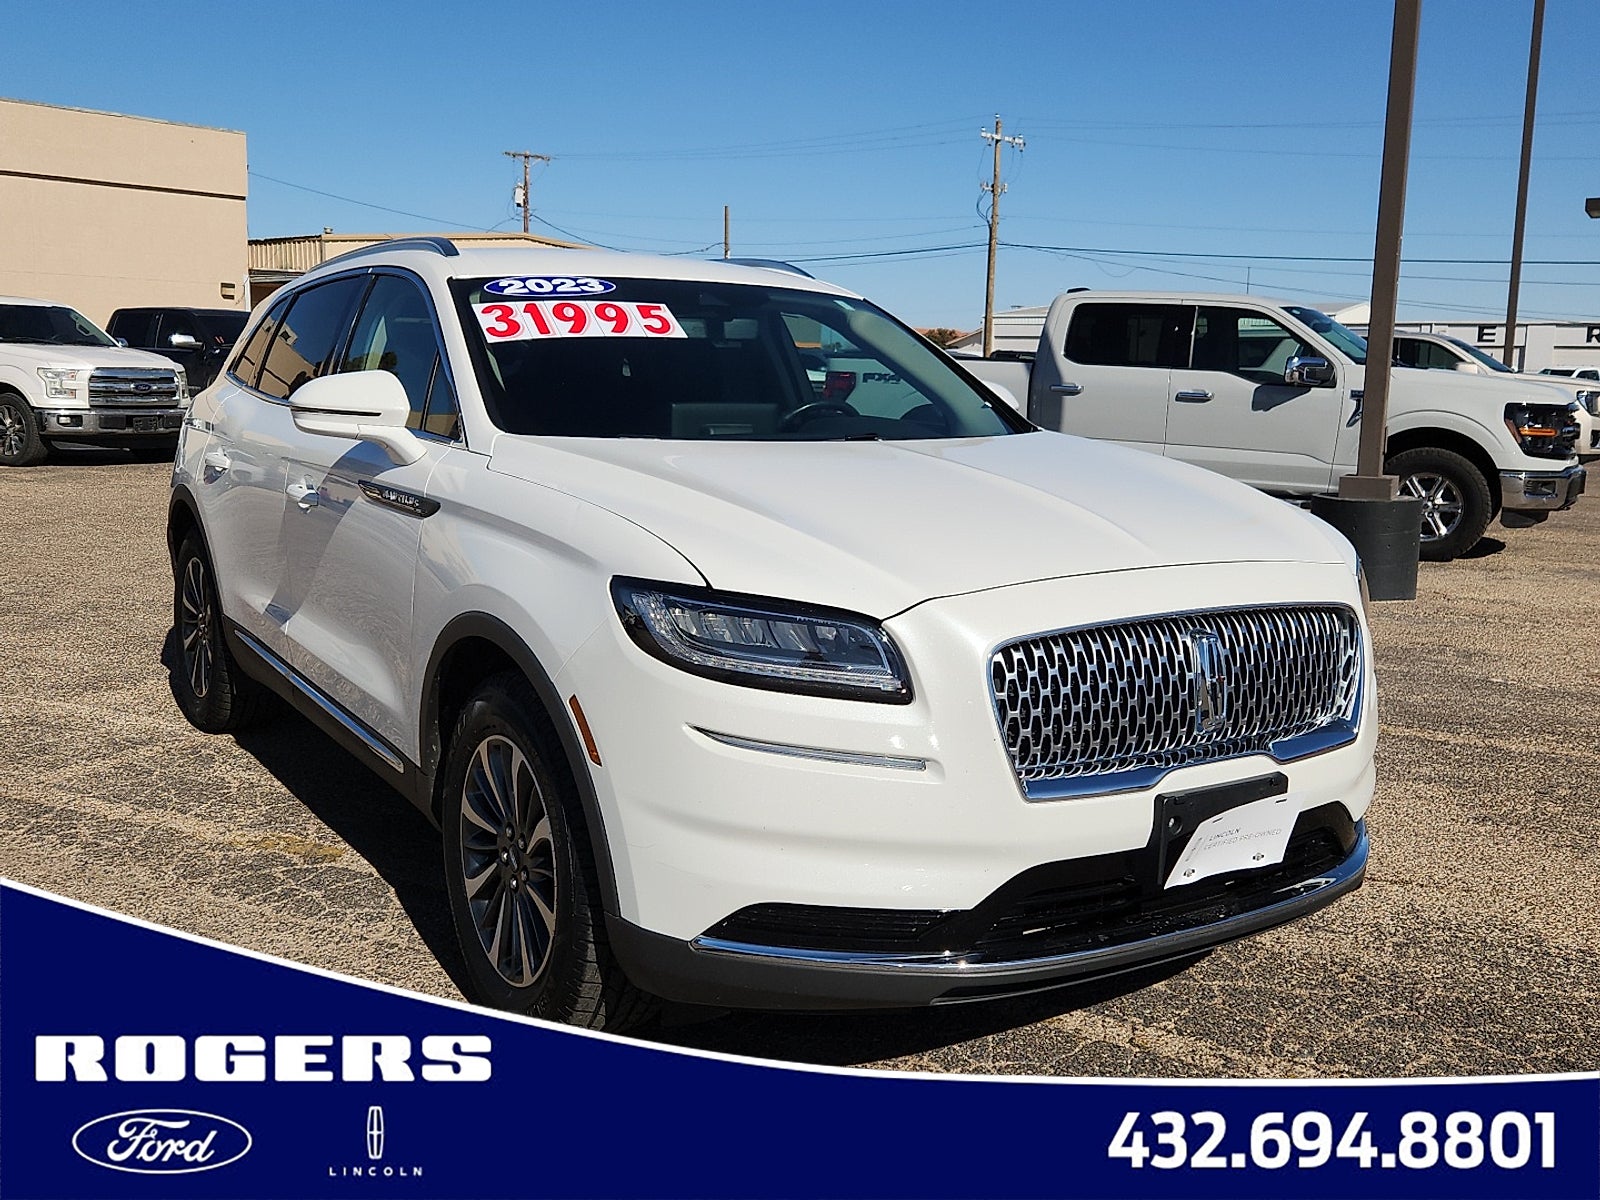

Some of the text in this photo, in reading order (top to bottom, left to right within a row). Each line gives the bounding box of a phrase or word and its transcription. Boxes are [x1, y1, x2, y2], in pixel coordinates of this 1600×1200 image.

[499, 278, 604, 294] 2023
[481, 303, 671, 337] 31995
[1208, 828, 1241, 841] LINCOLN
